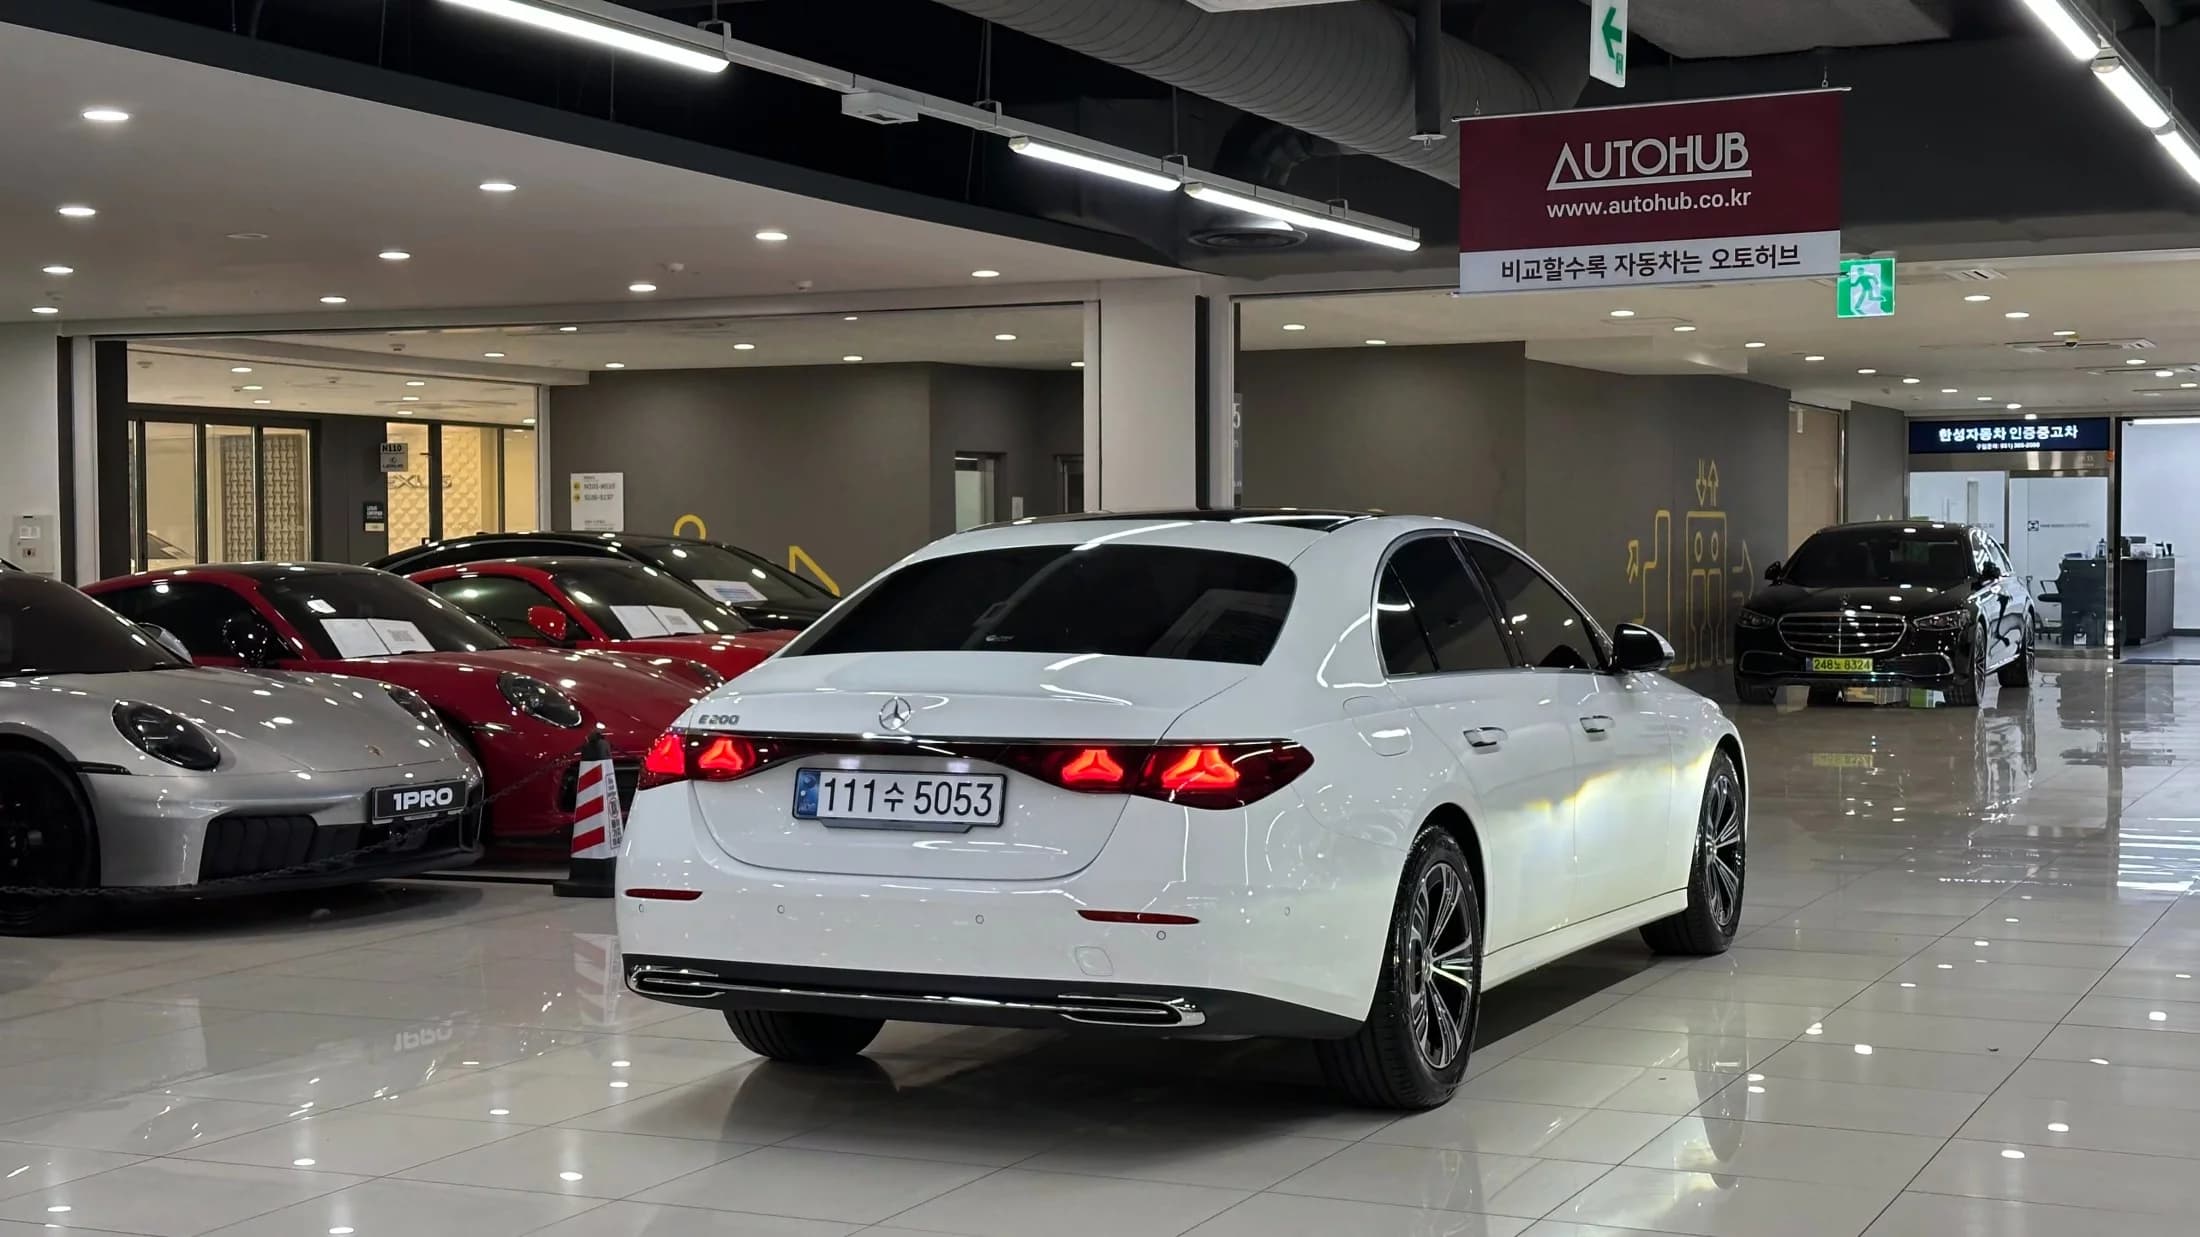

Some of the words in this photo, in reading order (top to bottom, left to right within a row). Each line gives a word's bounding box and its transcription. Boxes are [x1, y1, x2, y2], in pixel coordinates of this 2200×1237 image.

[1546, 131, 1752, 190] AUTOHUB
[1546, 188, 1752, 218] www.autohub.co.kr
[1501, 254, 1607, 282] 비교할수록
[1613, 249, 1703, 277] 자동차는
[1709, 244, 1801, 271] 오토허브
[1938, 427, 2006, 442] 한성자동차
[2009, 425, 2078, 440] 인증중고차
[1844, 658, 1870, 670] 8324
[698, 714, 709, 725] E
[709, 714, 740, 725] 200
[393, 787, 453, 811] 1PRO
[824, 777, 905, 813] 111수
[913, 781, 994, 816] 5053
